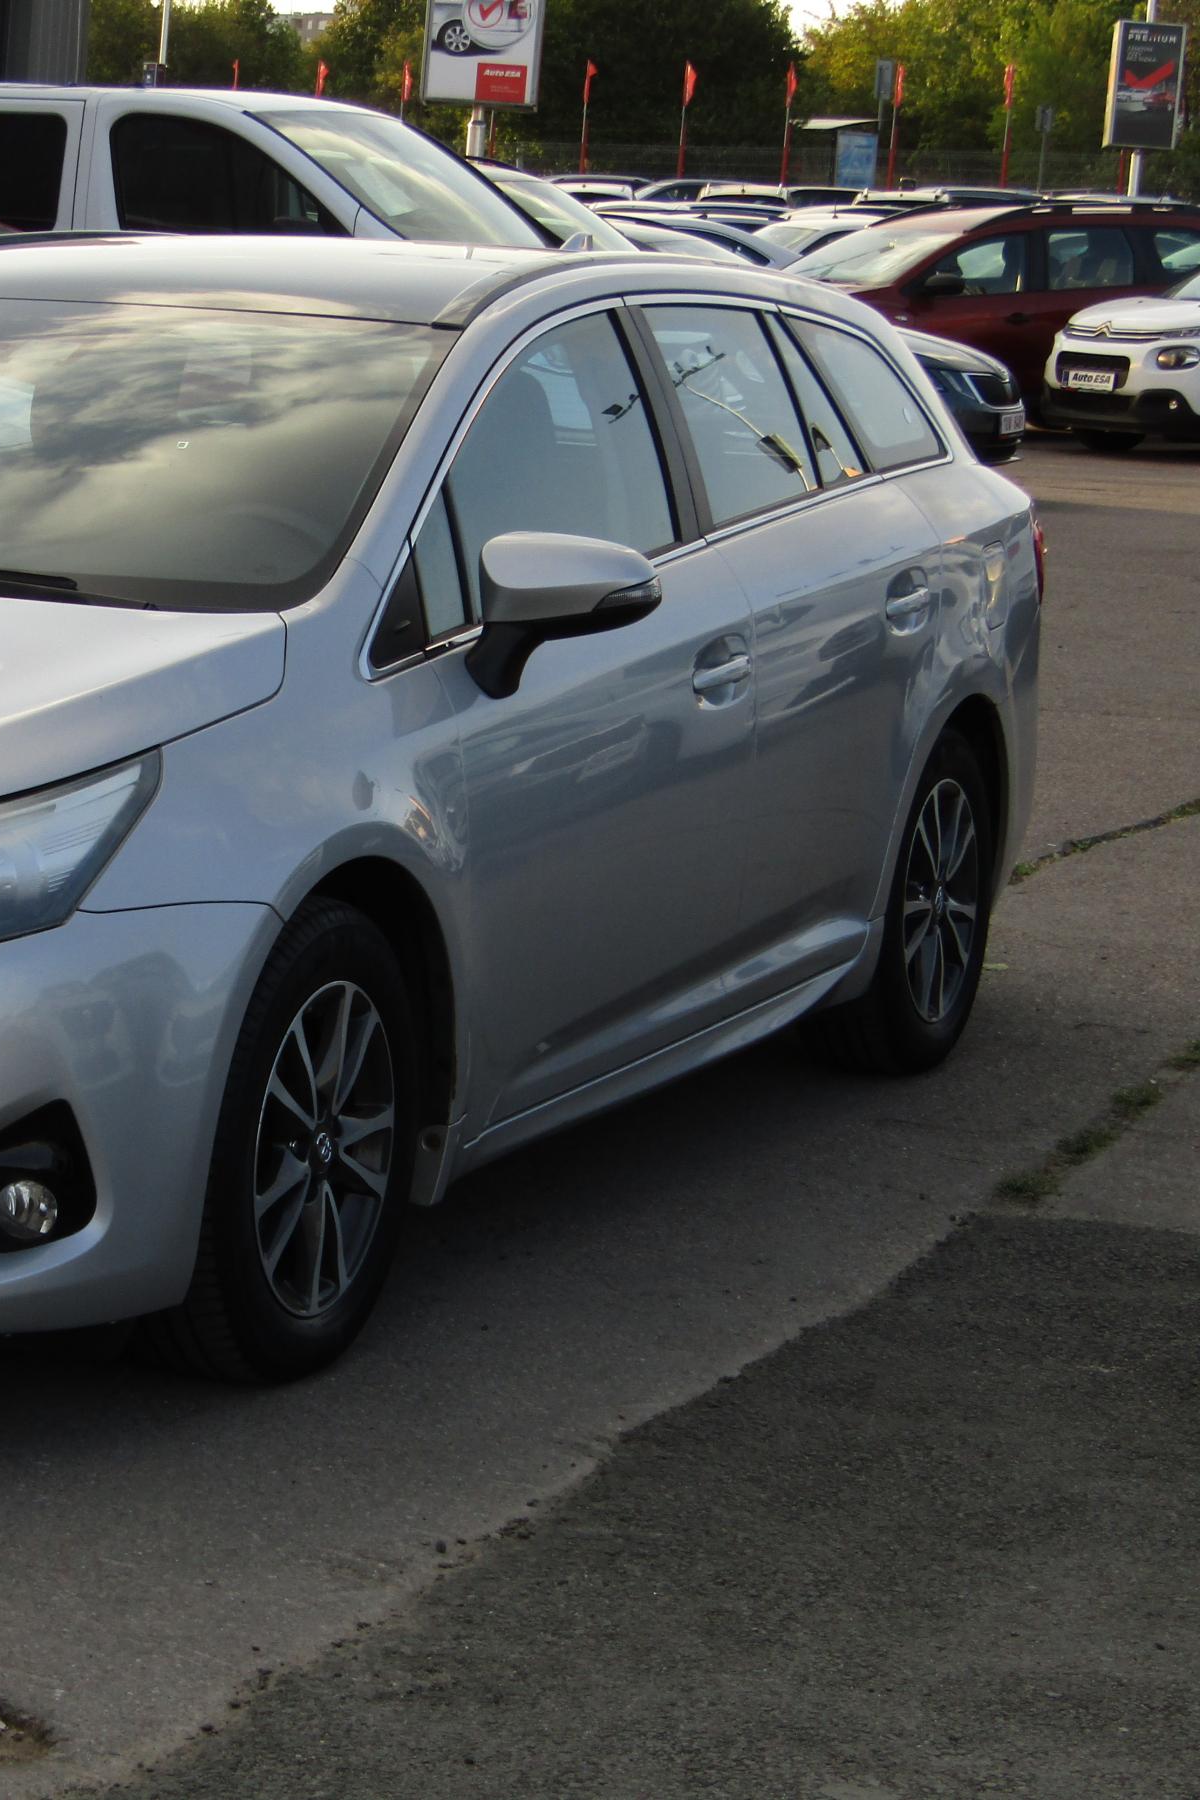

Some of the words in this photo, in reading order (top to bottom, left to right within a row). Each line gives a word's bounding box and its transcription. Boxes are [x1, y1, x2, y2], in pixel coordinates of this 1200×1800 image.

[483, 69, 504, 77] Auto
[1072, 373, 1093, 383] Auto
[1094, 375, 1111, 384] ESA
